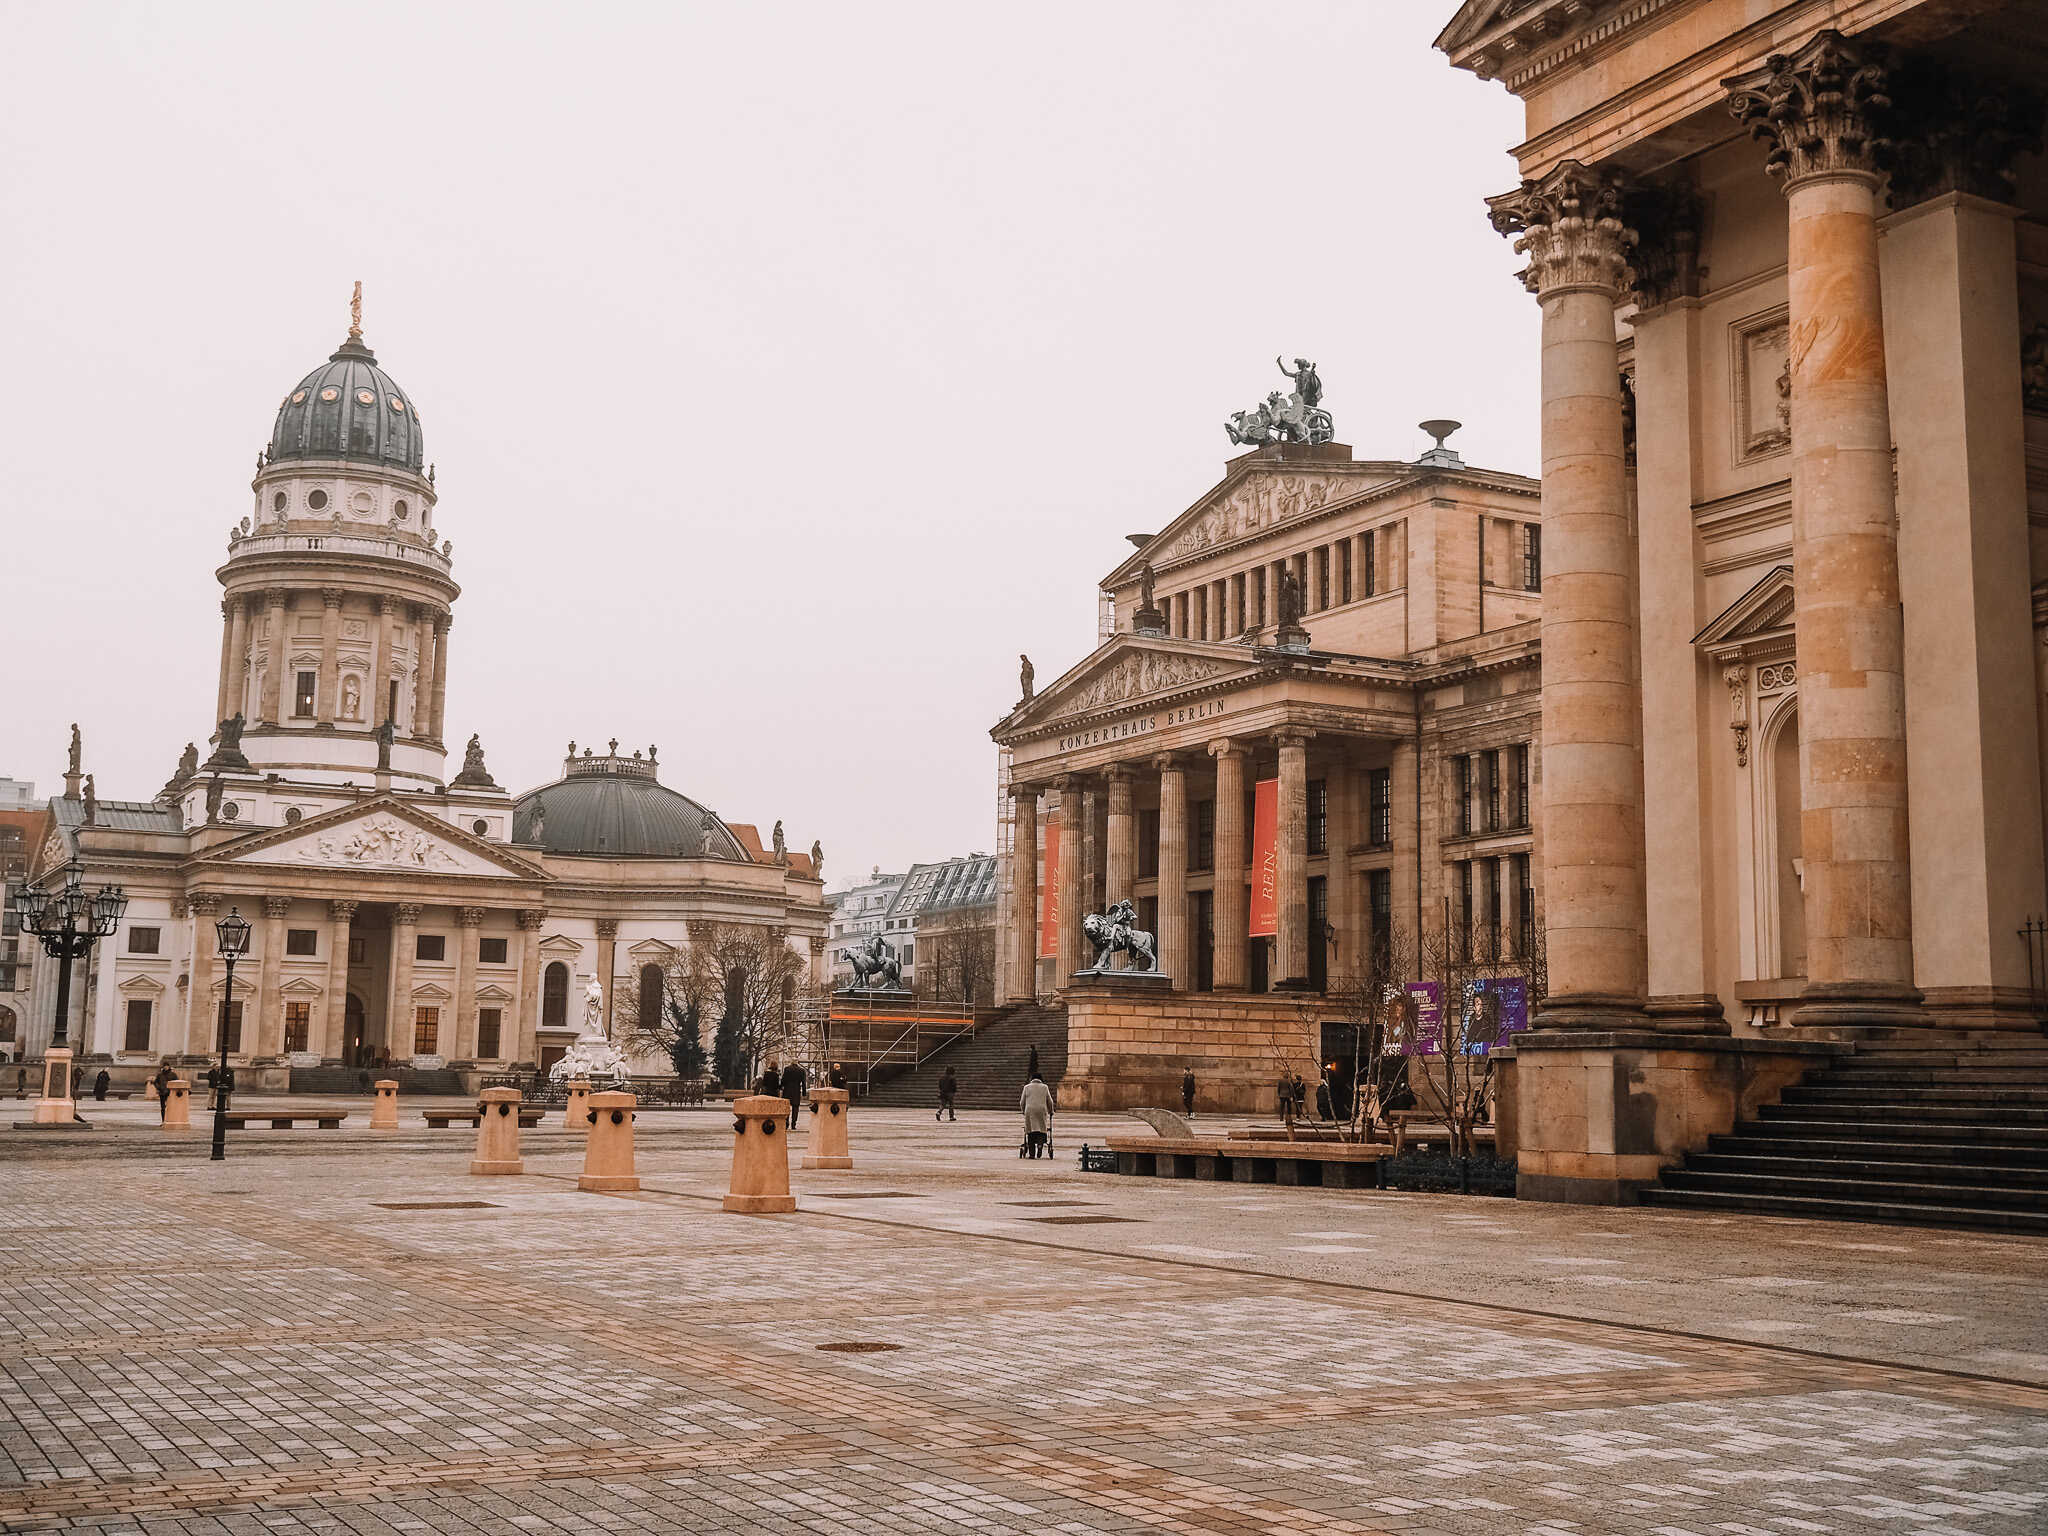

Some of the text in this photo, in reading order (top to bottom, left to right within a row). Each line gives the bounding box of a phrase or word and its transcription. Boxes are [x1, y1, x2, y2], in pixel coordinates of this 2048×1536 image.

[1059, 699, 1225, 751] KONZERTHAUS BERLIN
[1262, 850, 1276, 901] REIN
